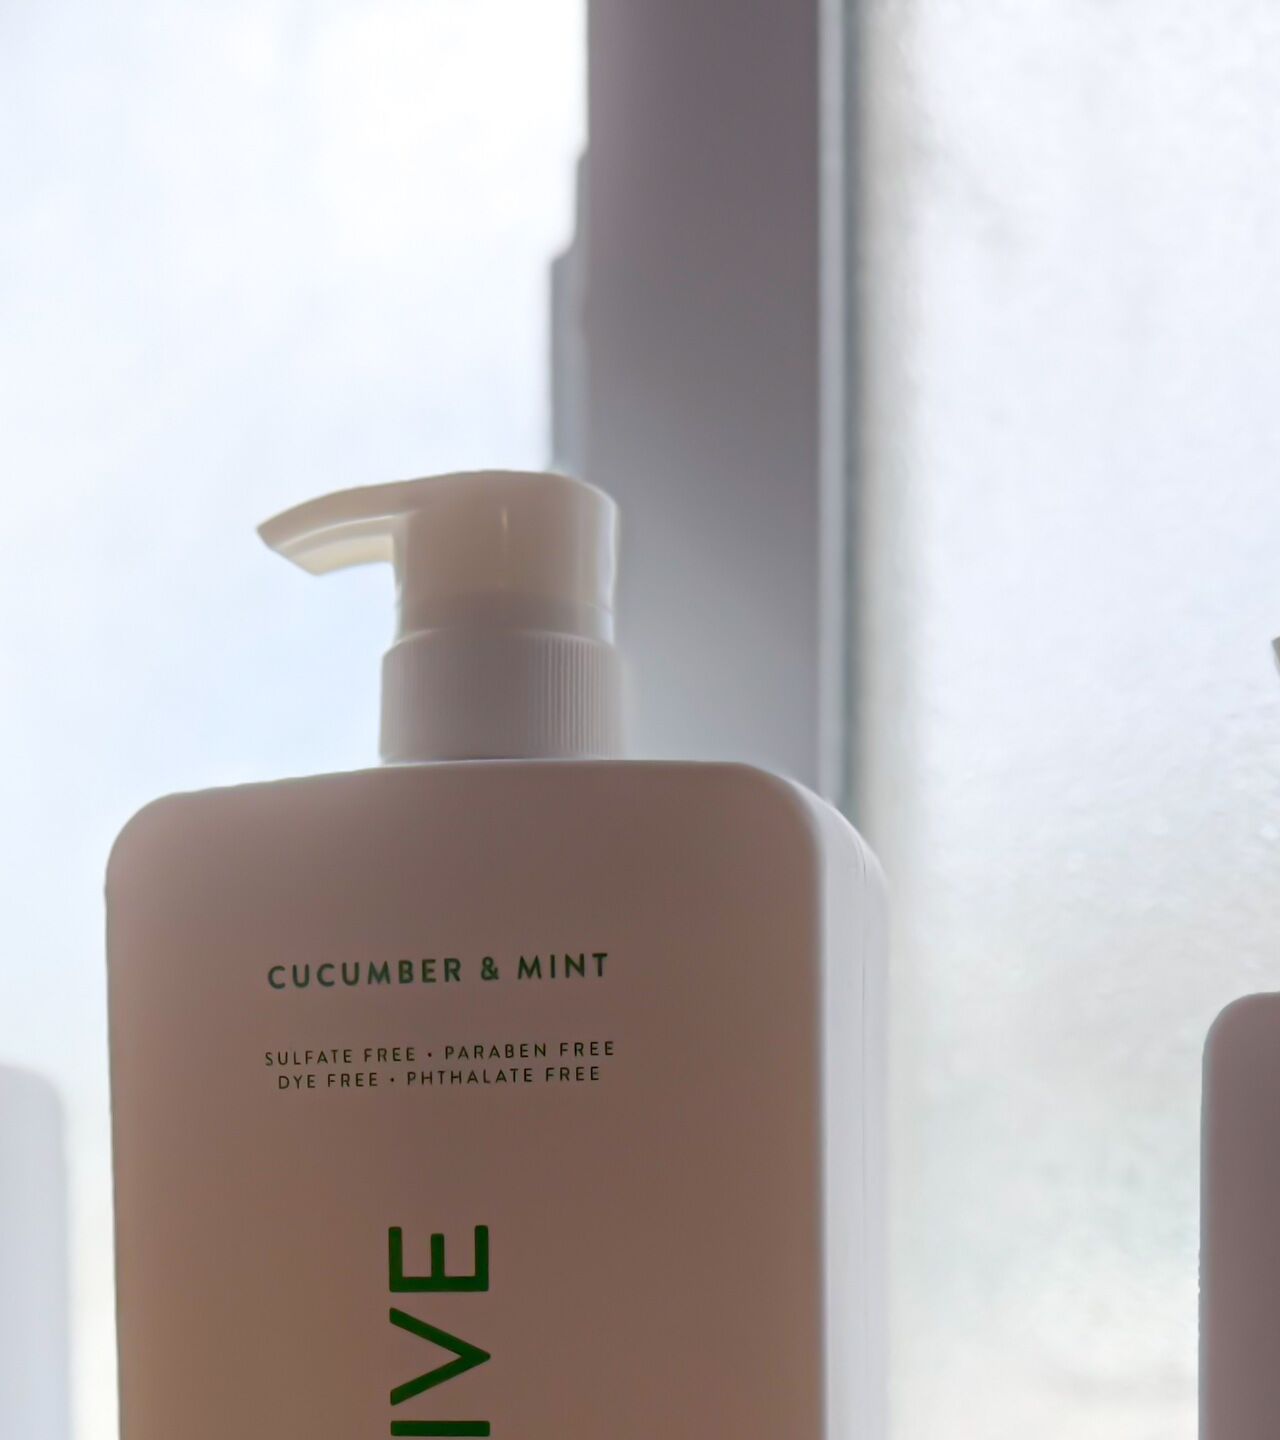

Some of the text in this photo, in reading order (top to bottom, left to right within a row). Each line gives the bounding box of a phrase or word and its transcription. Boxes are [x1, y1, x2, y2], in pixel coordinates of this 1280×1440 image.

[267, 952, 609, 990] CUCUMBER & MINT
[264, 1040, 614, 1067] SULFATE FREE PARABEN FREE
[277, 1065, 600, 1091] DYE FREE PHTHALATE FREE
